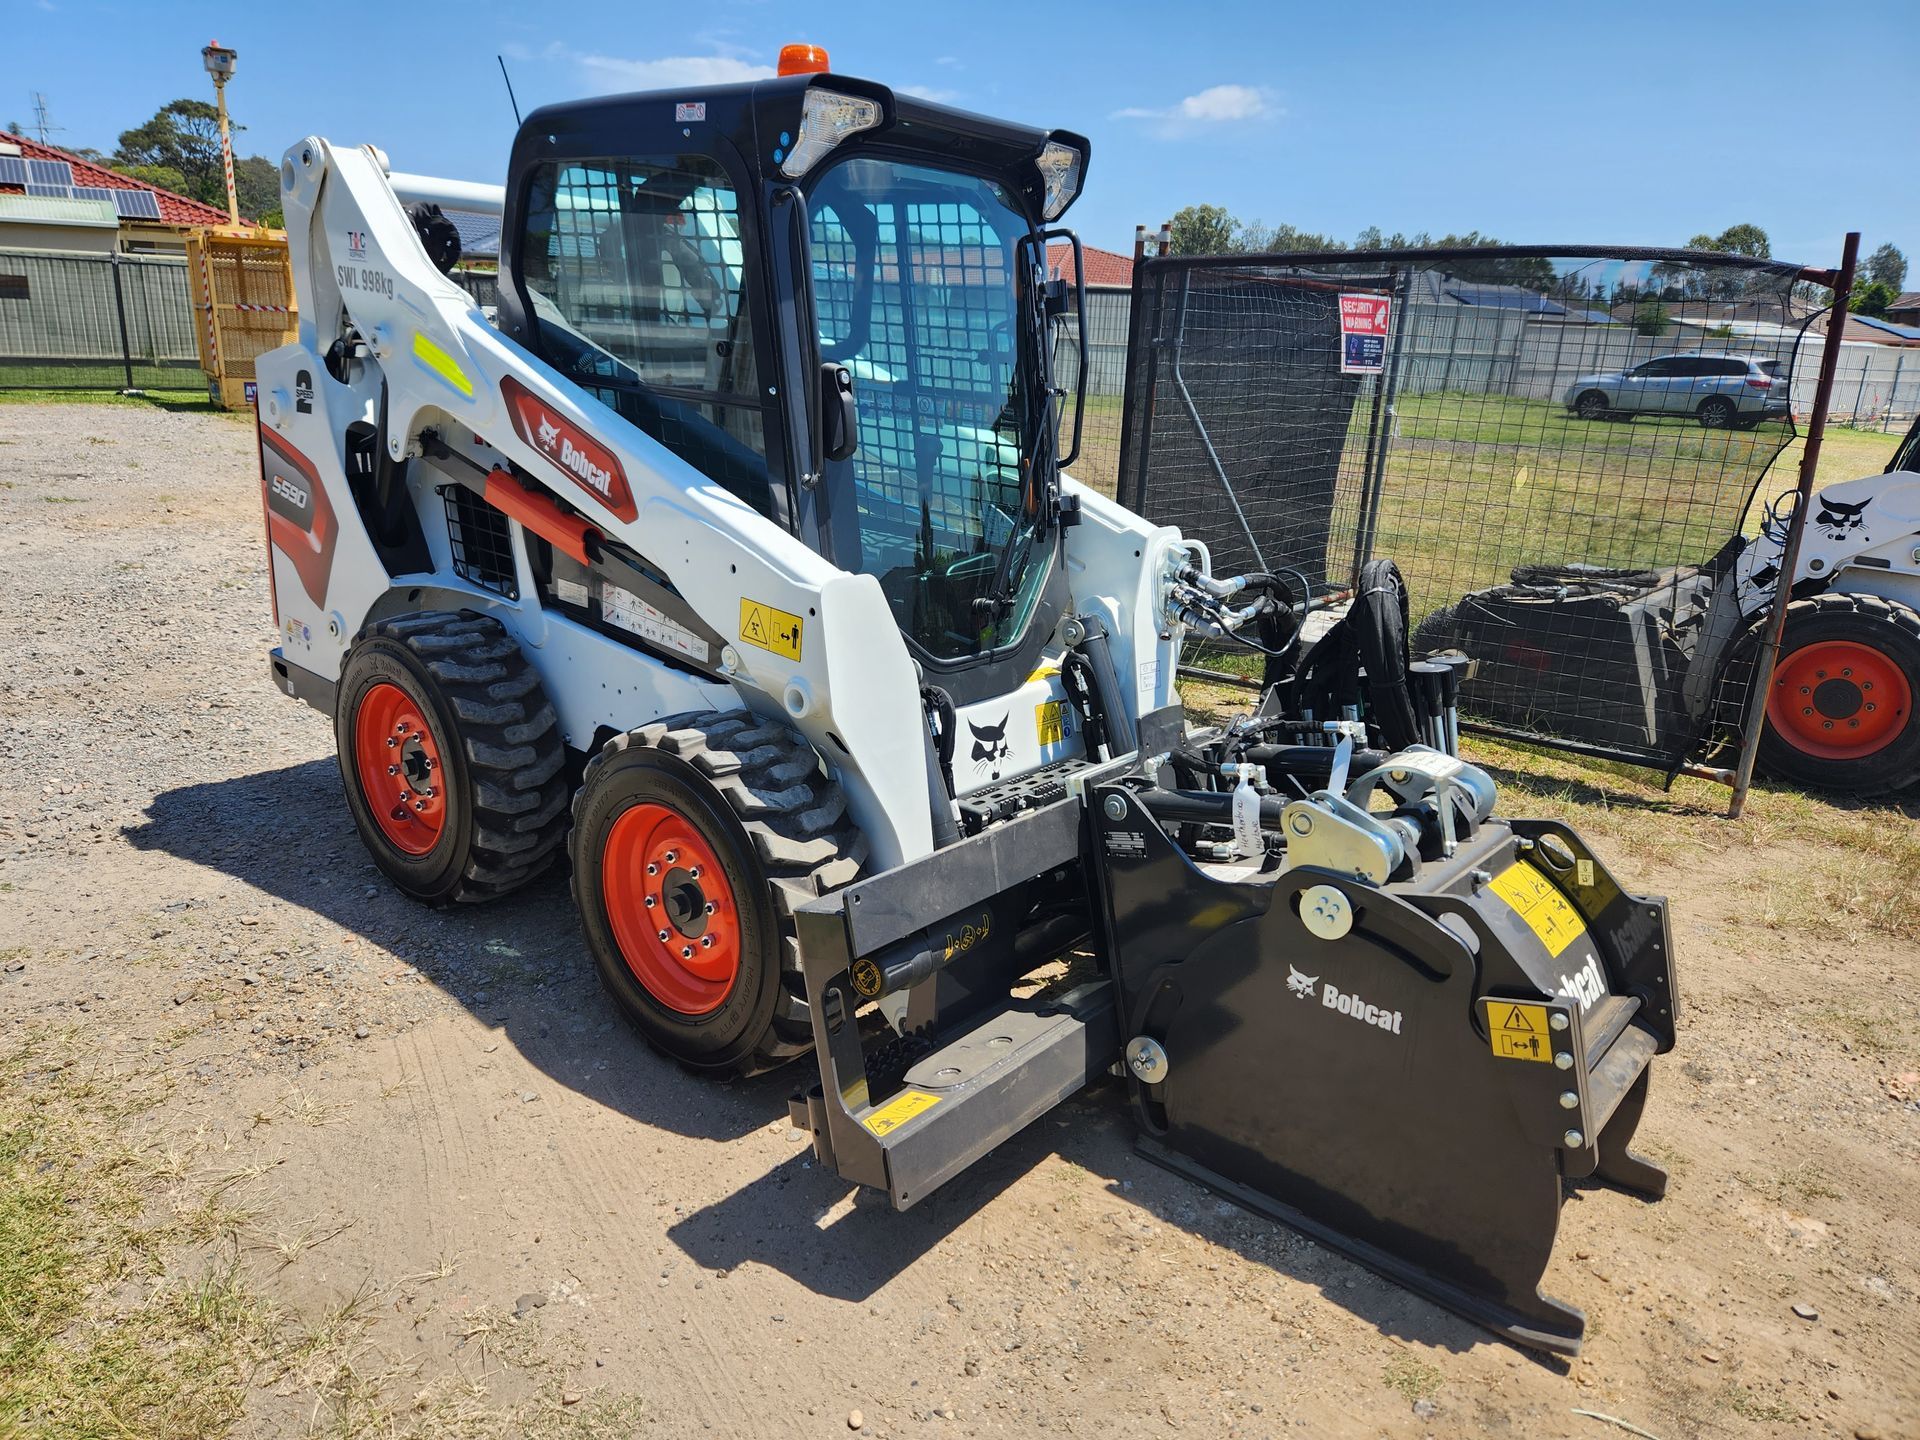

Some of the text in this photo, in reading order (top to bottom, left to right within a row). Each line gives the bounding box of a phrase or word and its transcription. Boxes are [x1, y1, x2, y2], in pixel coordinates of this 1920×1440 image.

[338, 265, 394, 301] SWL 998kg
[1343, 301, 1373, 314] SECURITY
[1345, 316, 1372, 330] WARNING
[561, 438, 611, 497] Bobcat
[272, 475, 308, 509] S590
[1322, 983, 1403, 1035] Bobcat
